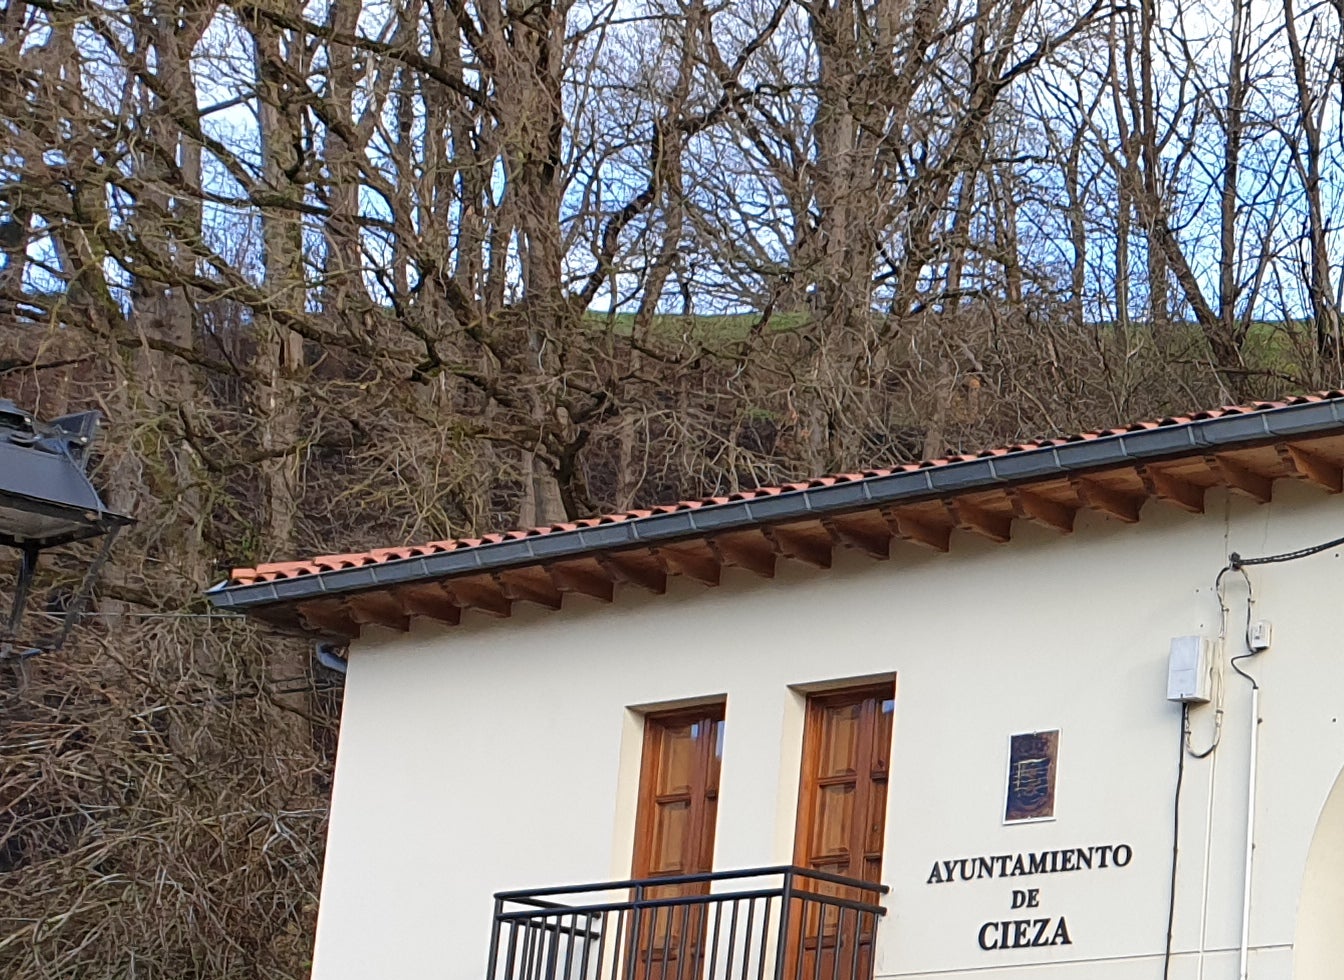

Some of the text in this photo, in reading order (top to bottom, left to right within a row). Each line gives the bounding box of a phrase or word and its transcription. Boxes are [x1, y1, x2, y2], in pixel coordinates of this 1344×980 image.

[927, 844, 1132, 884] AYUNTAMIENTO
[1010, 888, 1040, 909] DE
[978, 916, 1072, 951] CIEZA
